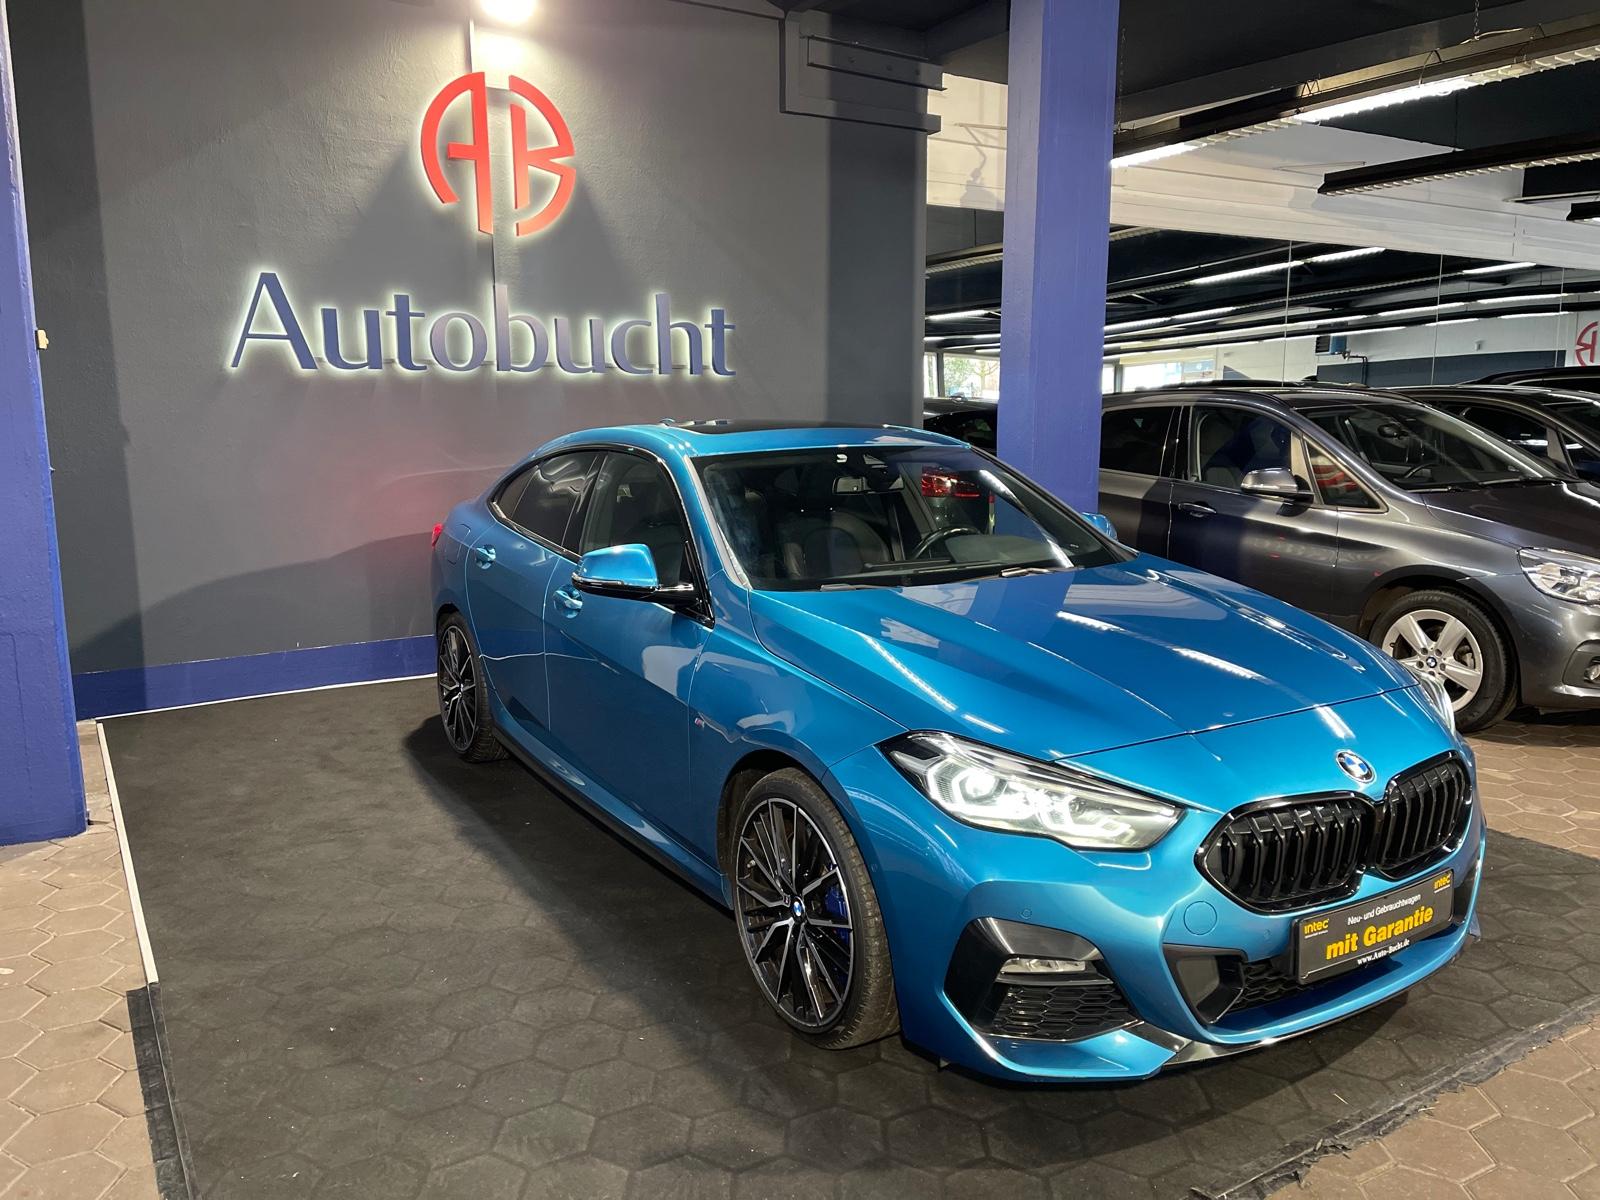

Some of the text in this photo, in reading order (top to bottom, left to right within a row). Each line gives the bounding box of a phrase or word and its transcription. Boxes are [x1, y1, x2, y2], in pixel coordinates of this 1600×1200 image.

[230, 272, 737, 376] Autobucht
[1326, 905, 1434, 960] mit Garantie
[1347, 894, 1422, 926] Neu- und Gebrauchtwagen
